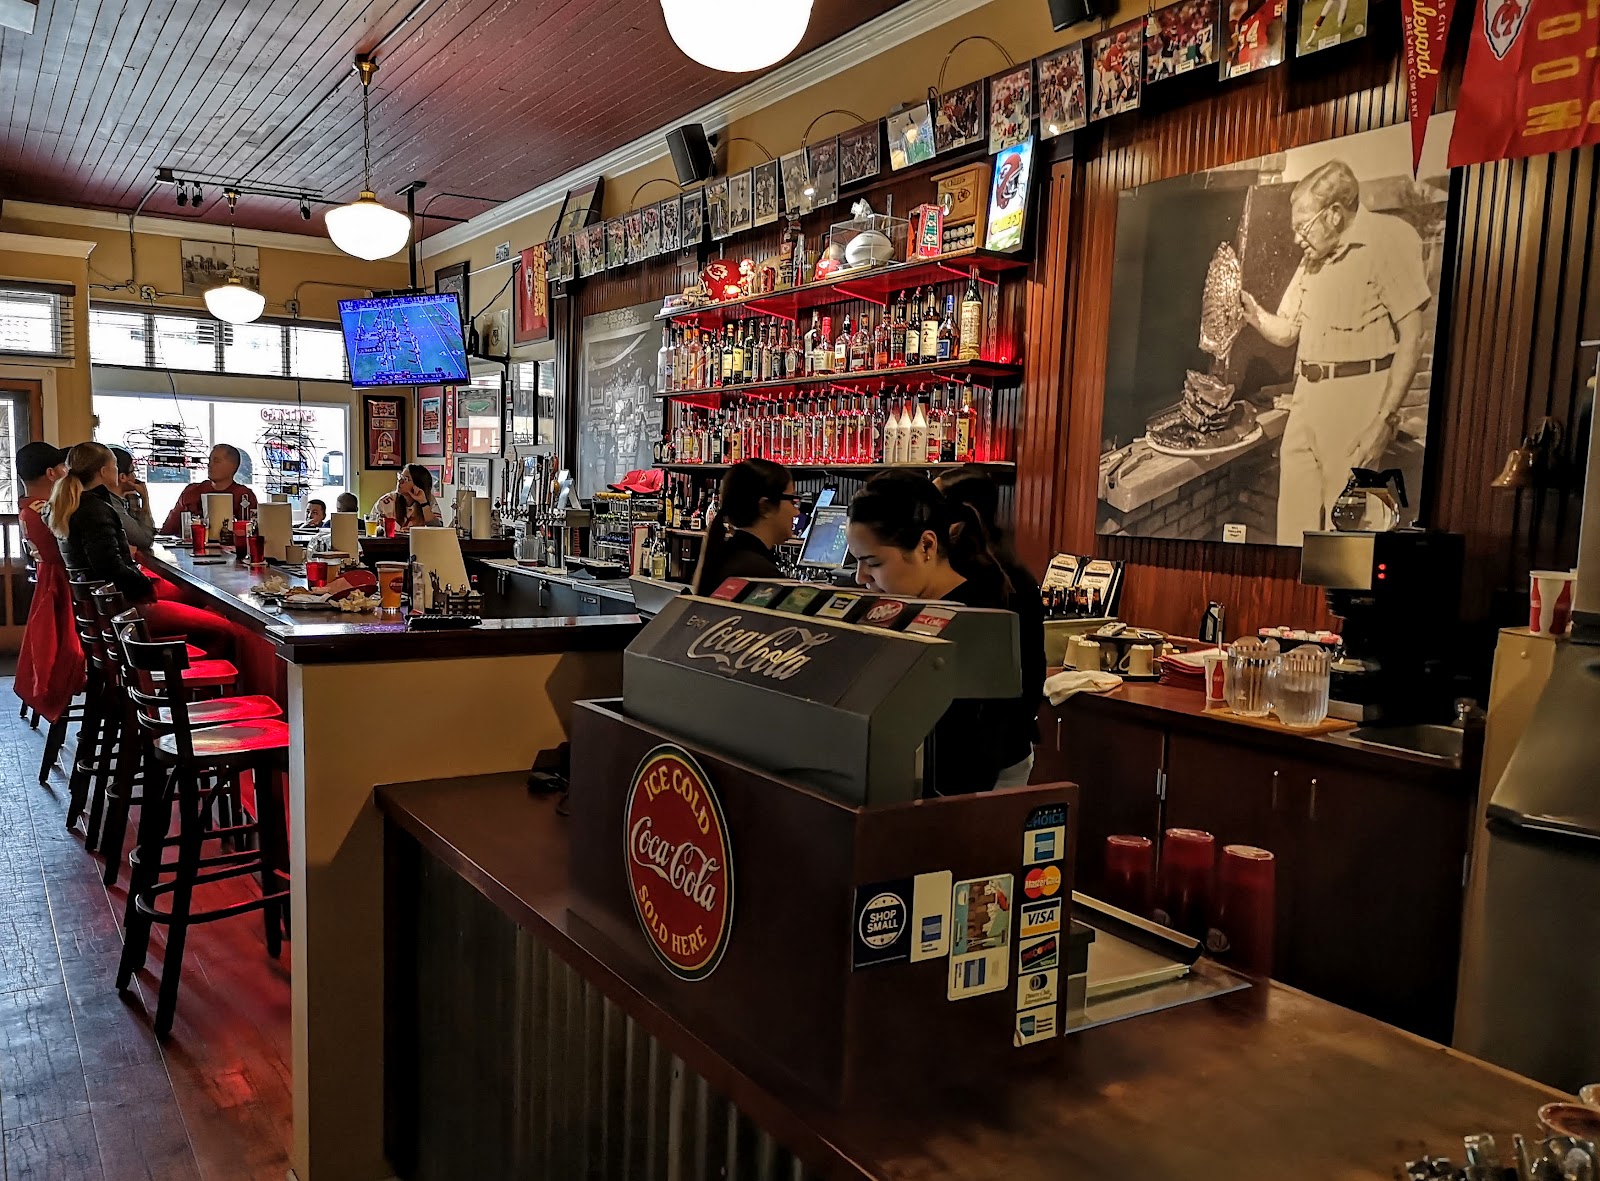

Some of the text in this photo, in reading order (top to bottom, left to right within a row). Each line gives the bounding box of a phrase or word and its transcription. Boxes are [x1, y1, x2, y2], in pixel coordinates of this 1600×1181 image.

[1436, 14, 1446, 41] CITY
[1404, 15, 1419, 118] BREWING COMPANY
[687, 615, 837, 681] Coca-Cola
[643, 764, 711, 835] ICE COLD
[630, 816, 721, 912] Coca-Cola
[638, 884, 708, 956] SOLD HERE
[866, 918, 899, 934] SMALL
[869, 909, 897, 922] SHOP
[1027, 908, 1055, 927] VISA
